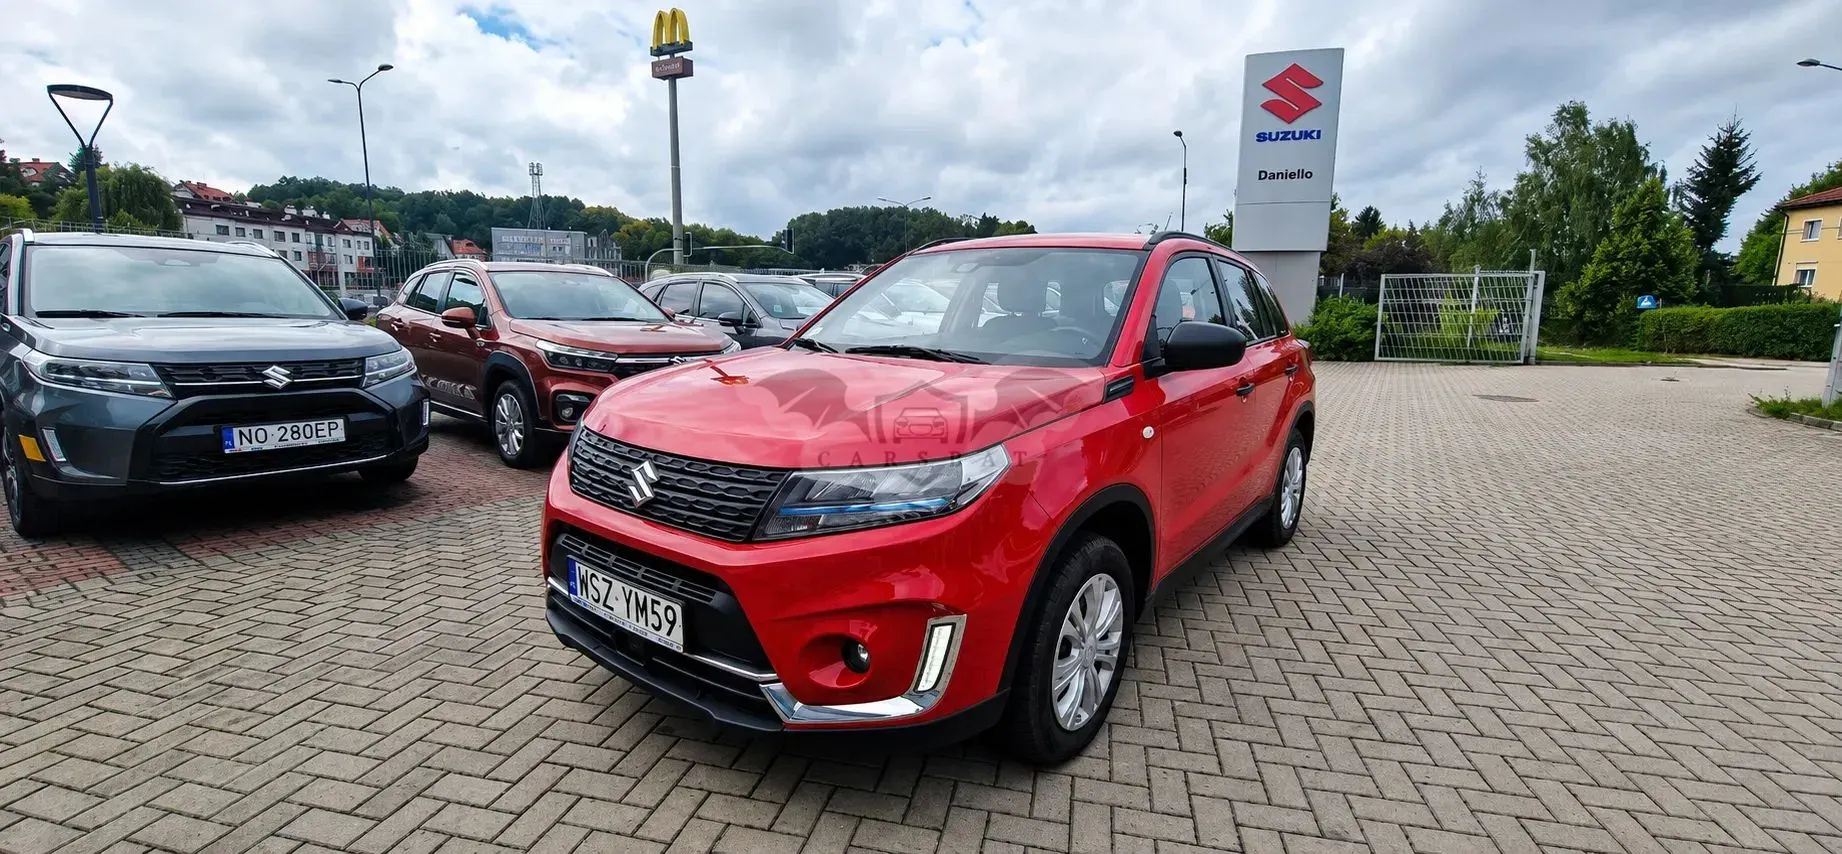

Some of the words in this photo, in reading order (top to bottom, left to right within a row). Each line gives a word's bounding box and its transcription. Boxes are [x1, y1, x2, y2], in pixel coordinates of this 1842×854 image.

[1255, 129, 1322, 143] SUZUKI
[1258, 168, 1314, 181] Daniello
[238, 427, 268, 446] NO
[277, 421, 339, 443] 280EP
[578, 566, 614, 612] WSZ
[621, 585, 677, 637] YM59
